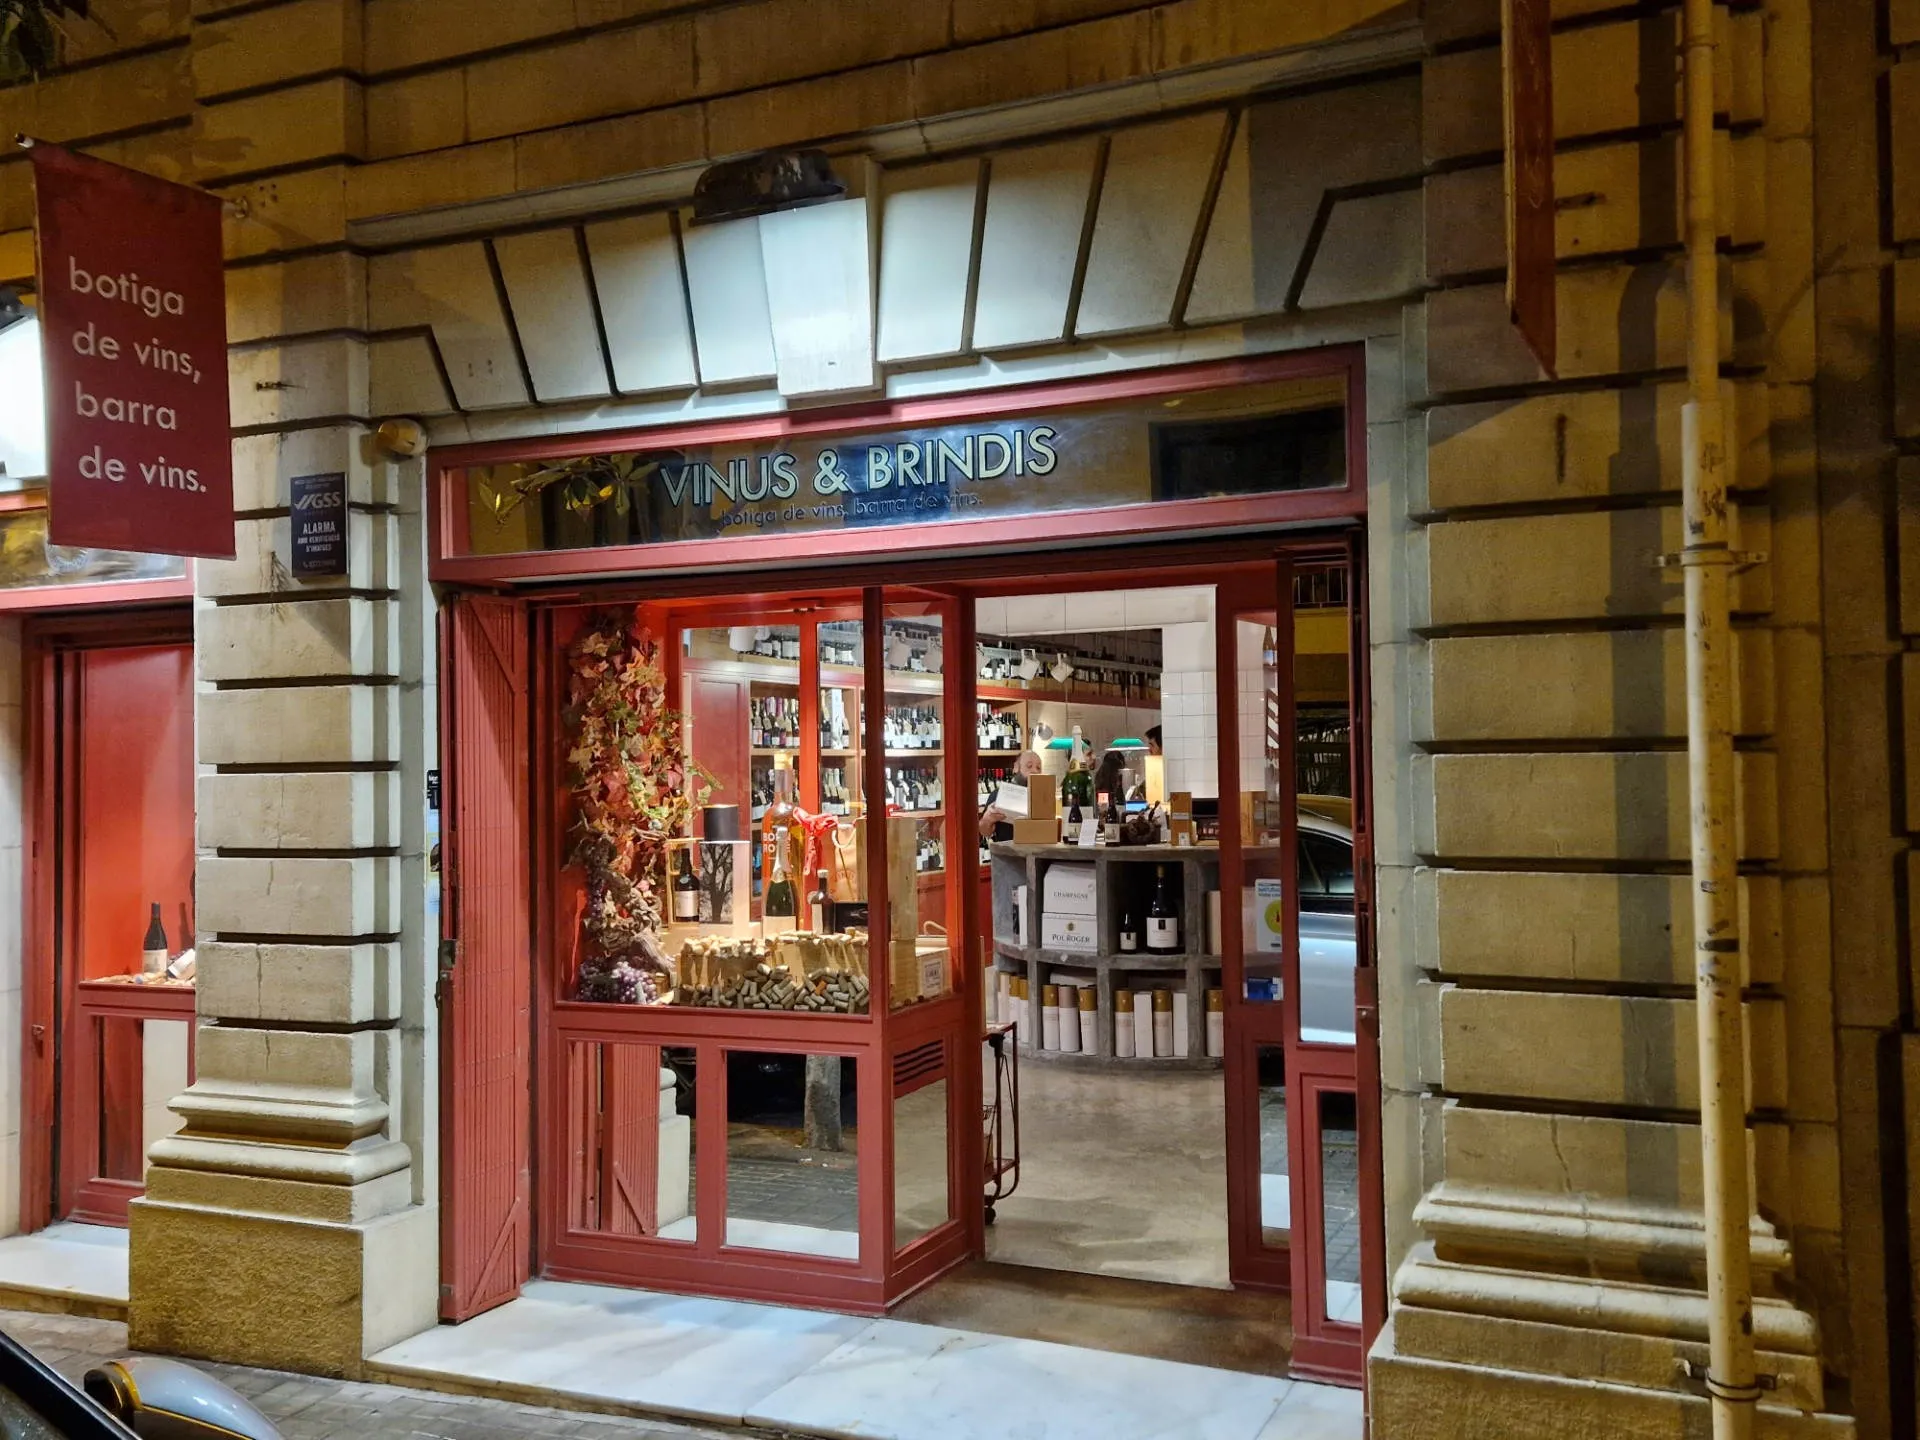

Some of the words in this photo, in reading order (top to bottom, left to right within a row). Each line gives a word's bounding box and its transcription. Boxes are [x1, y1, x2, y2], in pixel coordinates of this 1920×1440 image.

[68, 256, 184, 318] botiga
[72, 322, 120, 360] de
[134, 337, 201, 384] vins,
[75, 381, 177, 430] barra
[79, 446, 126, 482] de
[139, 456, 207, 494] vins.
[660, 452, 799, 507] VINUS
[812, 448, 850, 495] &
[866, 426, 1059, 490] BRINDIS
[311, 491, 341, 509] GSS
[721, 509, 776, 528] botiga
[783, 503, 804, 520] de
[853, 498, 905, 515] barra
[912, 491, 938, 508] de
[303, 521, 336, 535] ALARMA
[1052, 933, 1065, 942] POL
[1066, 934, 1091, 944] ROGER
